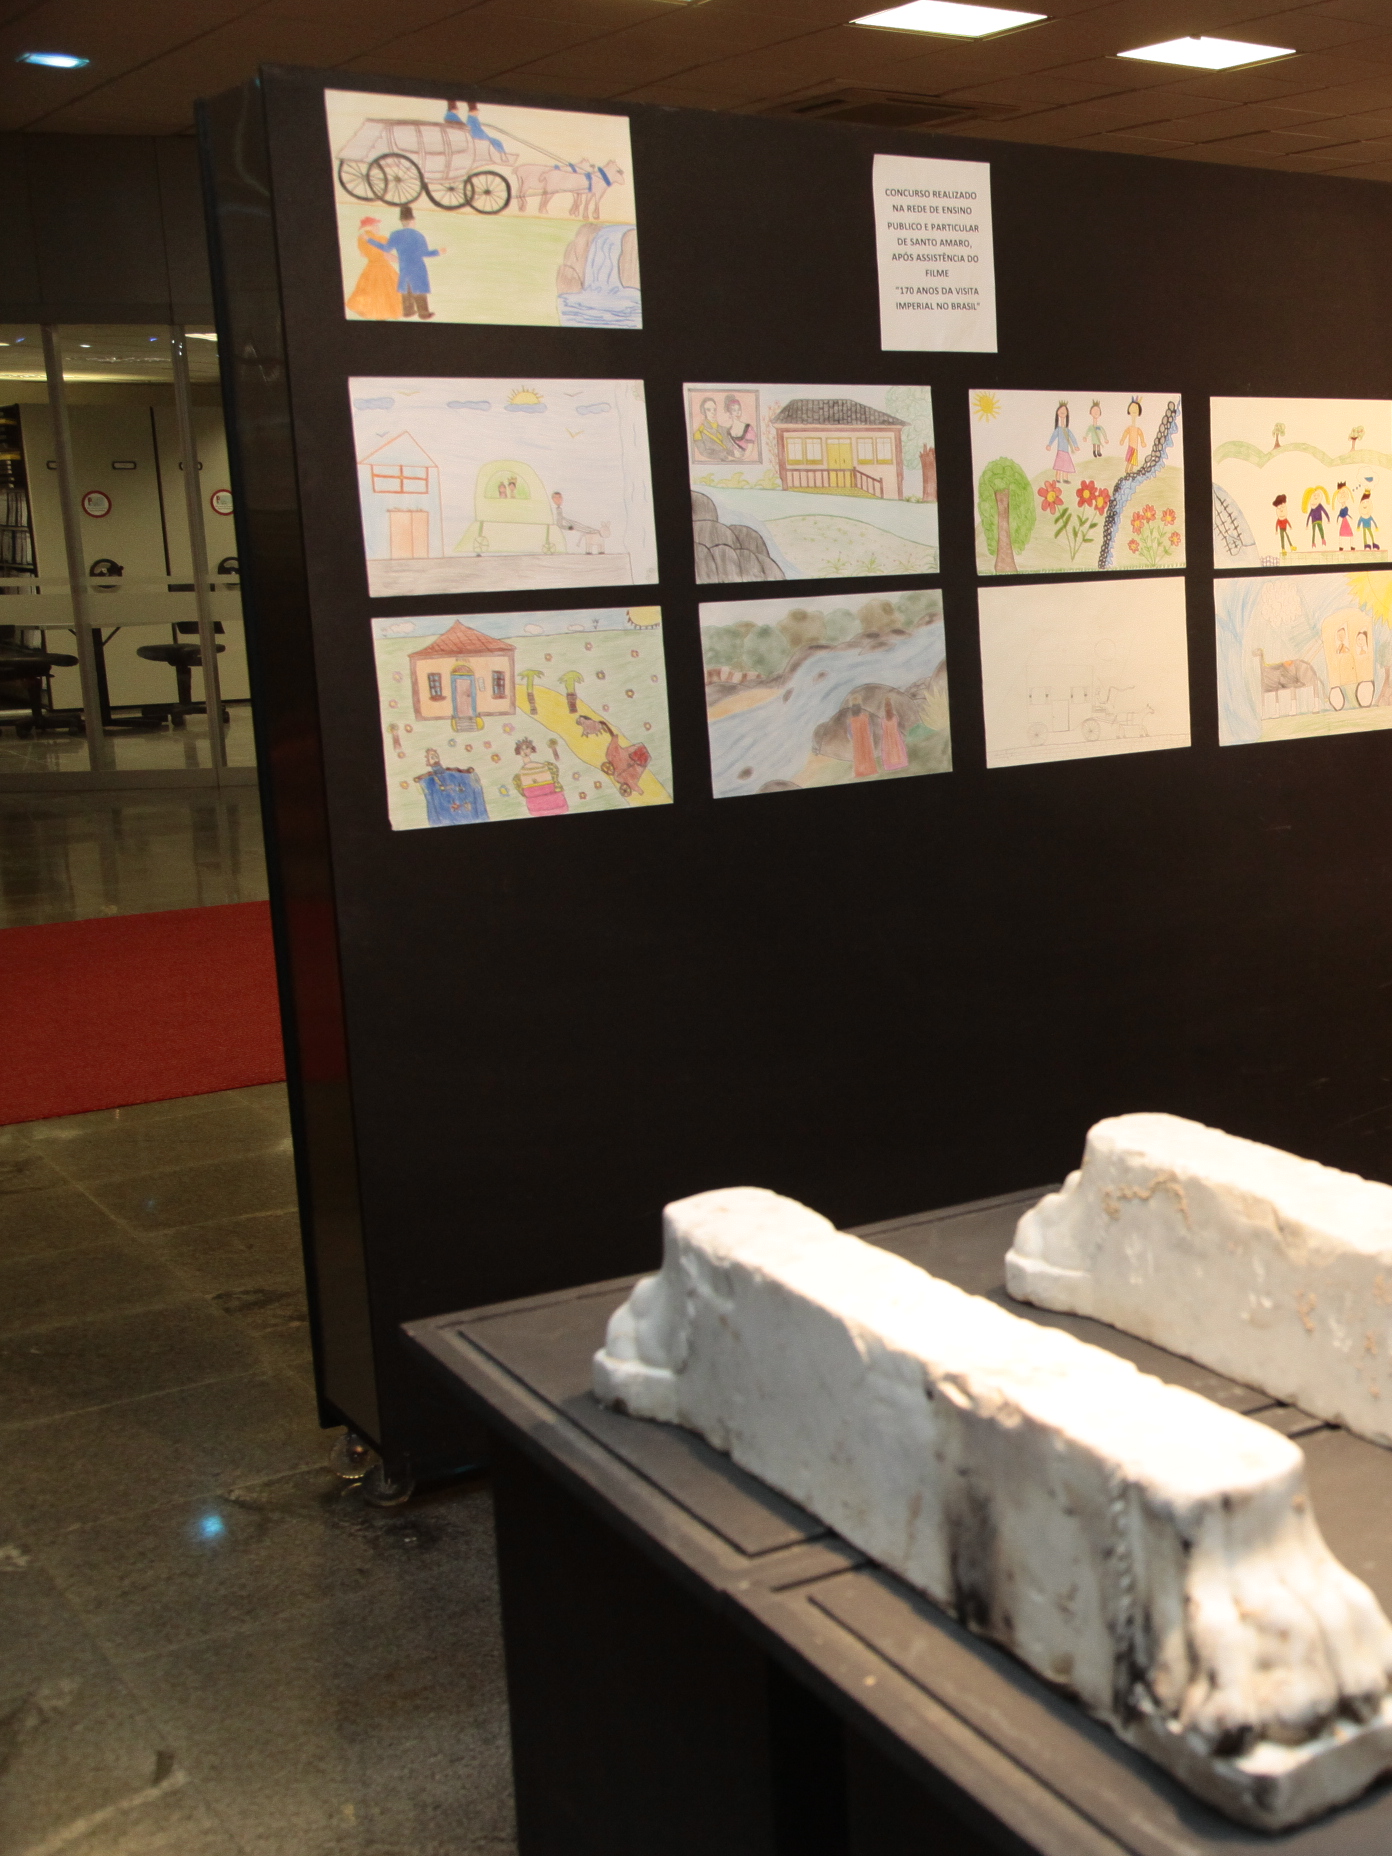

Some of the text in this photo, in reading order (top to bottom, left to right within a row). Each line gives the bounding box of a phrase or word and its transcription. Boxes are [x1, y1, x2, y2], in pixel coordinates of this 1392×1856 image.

[885, 188, 977, 200] CONCURSO REALIZADO
[892, 204, 972, 215] NA REDE DE ENSINO
[887, 222, 979, 233] PUBLICO E PARTICULAR
[897, 238, 972, 249] DE SANTO AMARO,
[892, 252, 979, 263] APÓS ASSISTÊNCIA DO
[925, 269, 949, 278] FILME
[916, 287, 939, 295] ANOS
[941, 287, 953, 295] DA
[955, 287, 979, 296] VISITA
[896, 302, 980, 311] IMPERIAL NO BRASIL"
